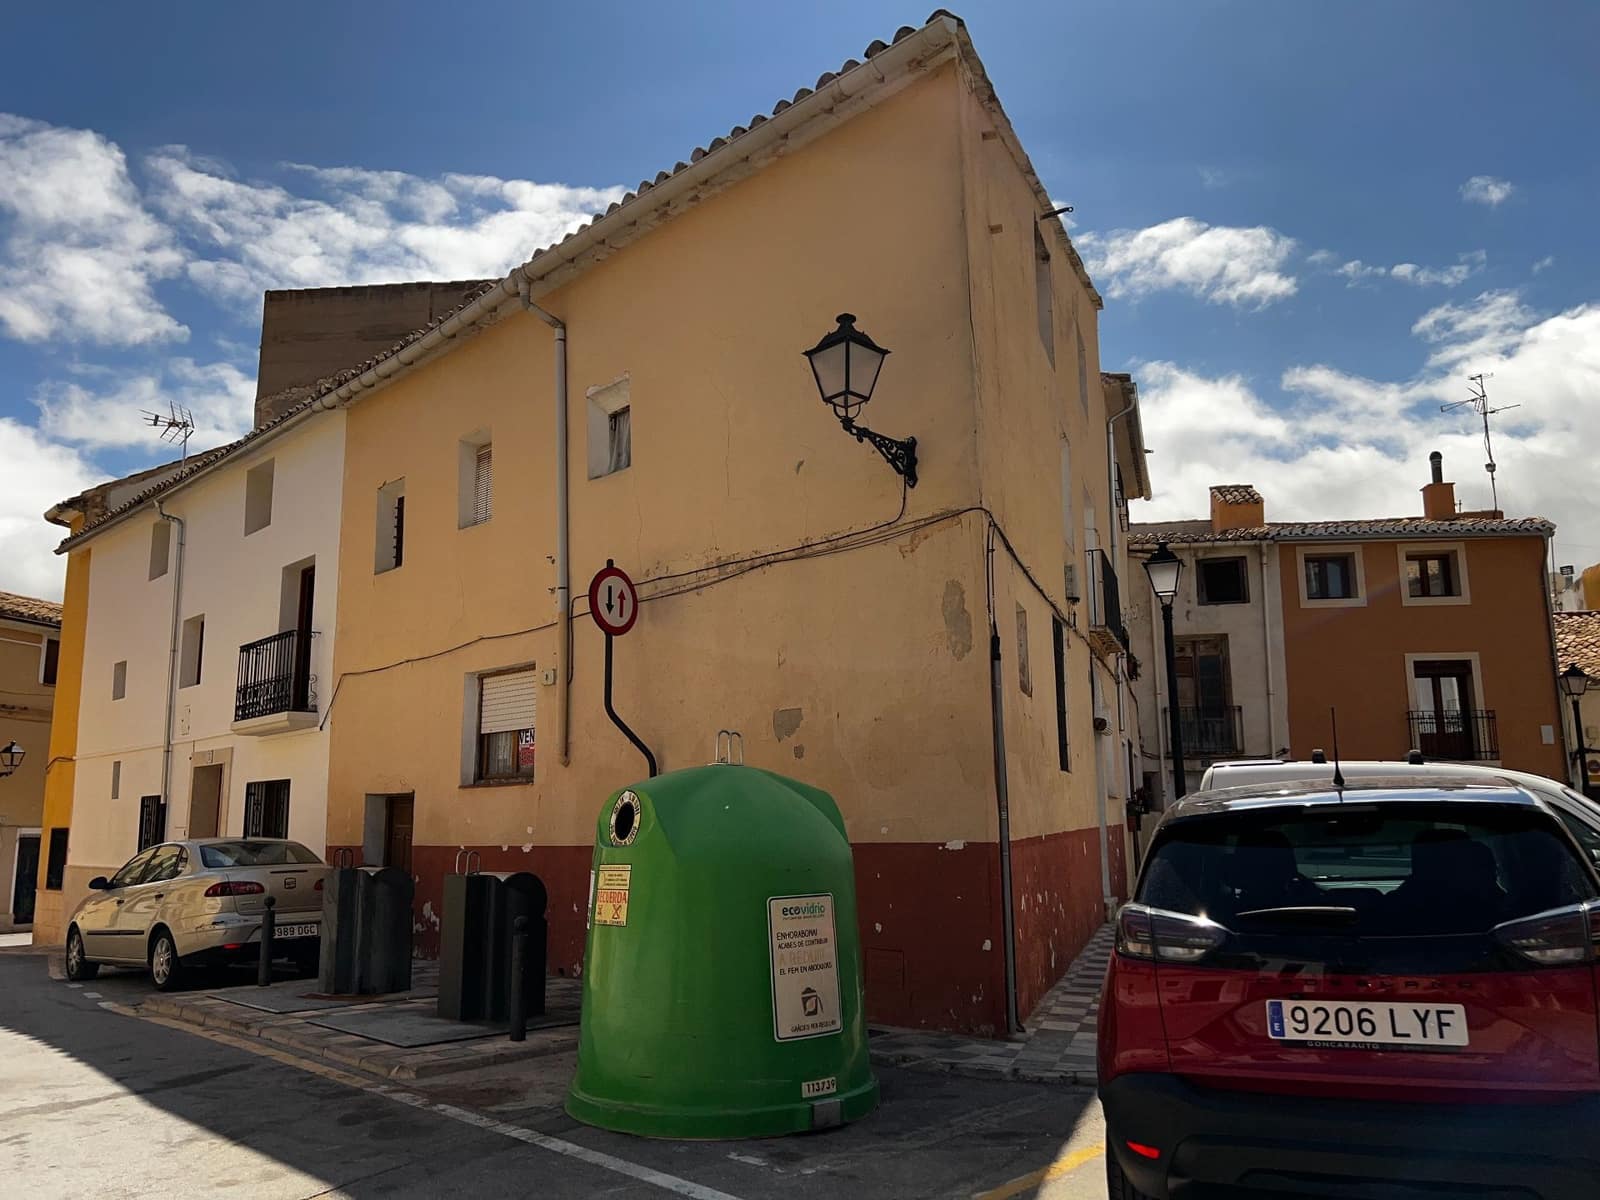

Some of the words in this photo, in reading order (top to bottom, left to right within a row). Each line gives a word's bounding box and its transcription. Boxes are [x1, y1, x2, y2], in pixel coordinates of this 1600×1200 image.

[782, 902, 826, 916] ecovidrio
[298, 925, 315, 935] DGC
[1290, 1006, 1377, 1037] 9206
[1389, 1008, 1455, 1040] LYF
